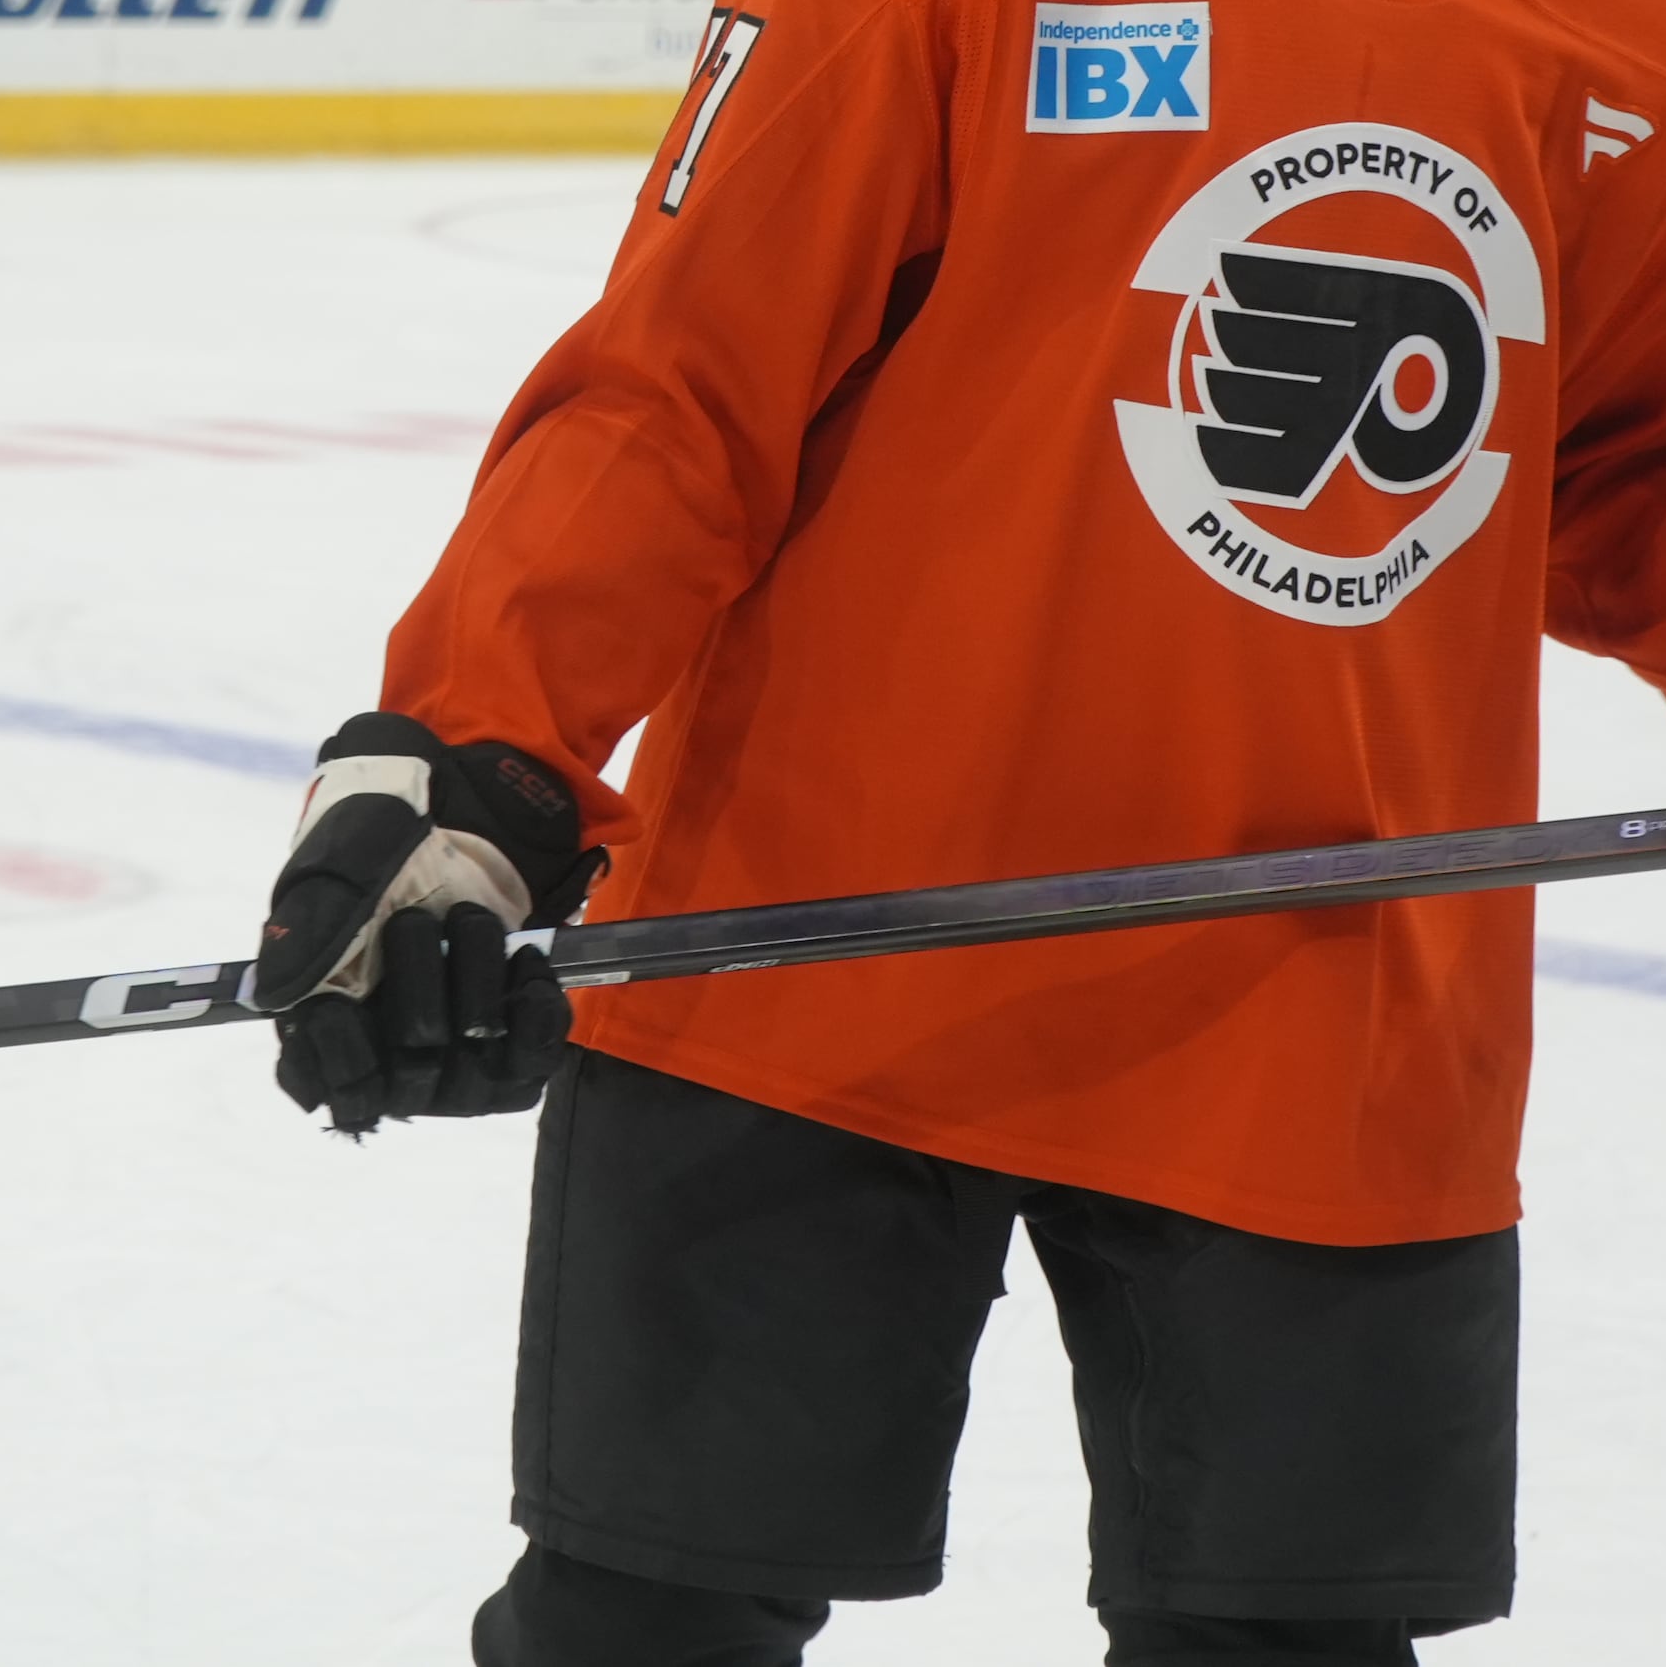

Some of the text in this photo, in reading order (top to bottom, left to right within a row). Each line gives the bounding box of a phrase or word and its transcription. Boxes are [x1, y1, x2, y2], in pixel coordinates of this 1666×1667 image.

[1039, 19, 1172, 42] Independence
[1034, 44, 1199, 120] IBX
[1252, 143, 1497, 234] PROPERTY OF
[1187, 510, 1430, 608] PHILADELPHIA
[1619, 818, 1647, 839] 8
